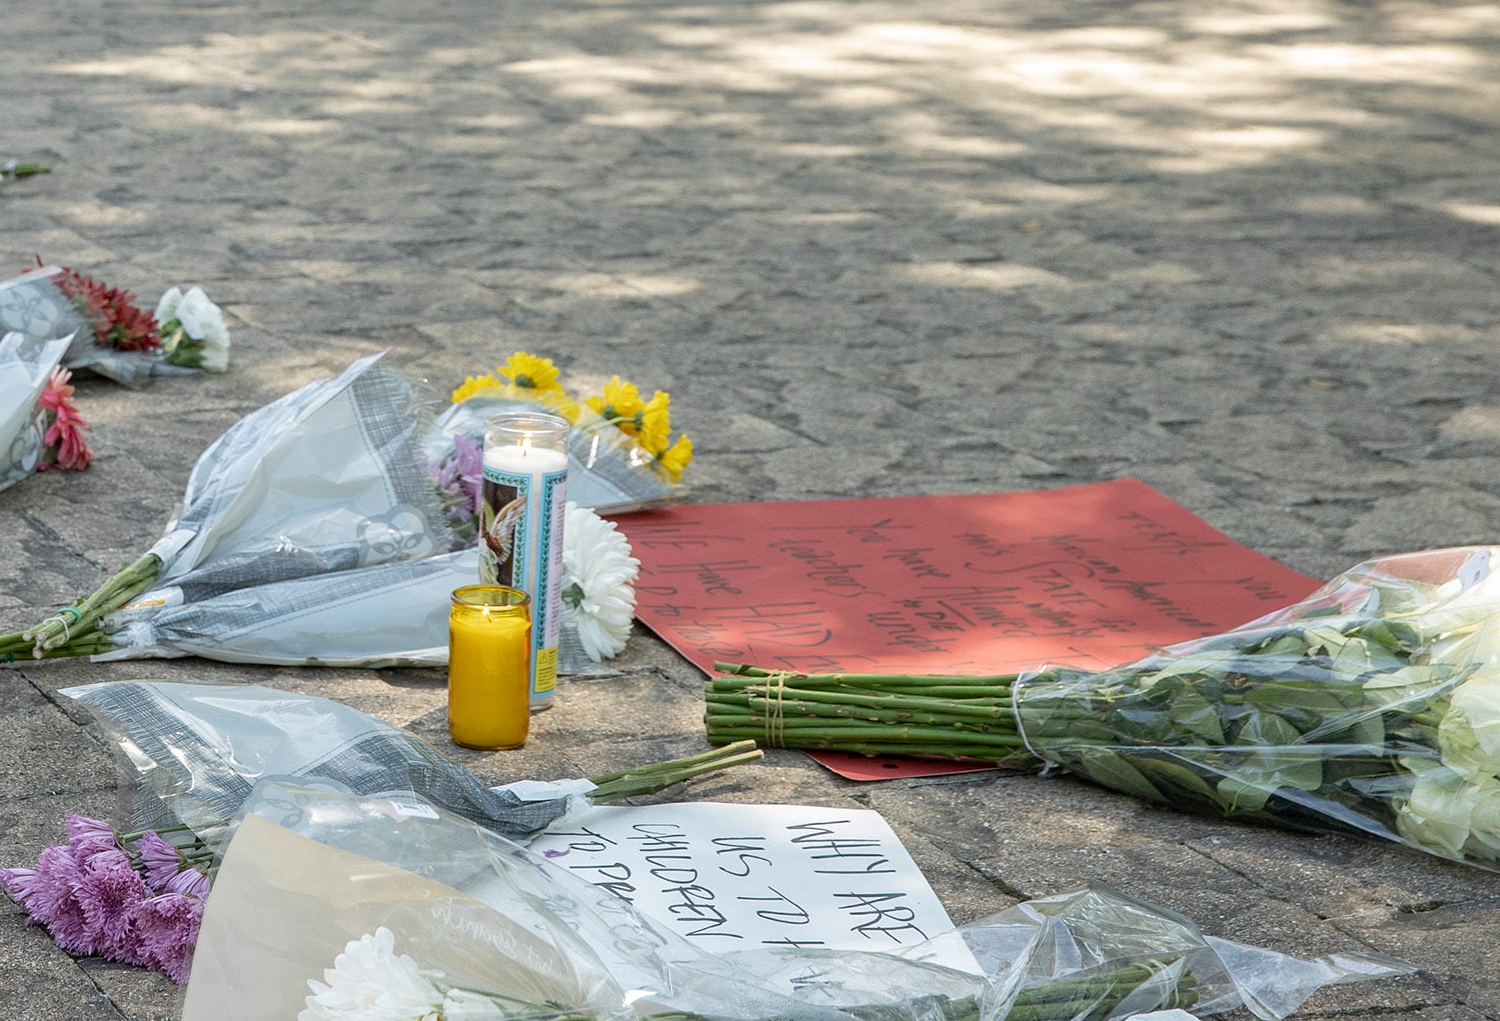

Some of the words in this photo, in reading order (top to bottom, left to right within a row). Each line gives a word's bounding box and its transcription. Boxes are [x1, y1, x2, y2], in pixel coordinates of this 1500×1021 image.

[710, 835, 774, 878] US
[786, 818, 897, 876] WHY
[626, 823, 744, 940] CHILDREN
[736, 884, 811, 925] TO
[832, 890, 932, 946] ARE
